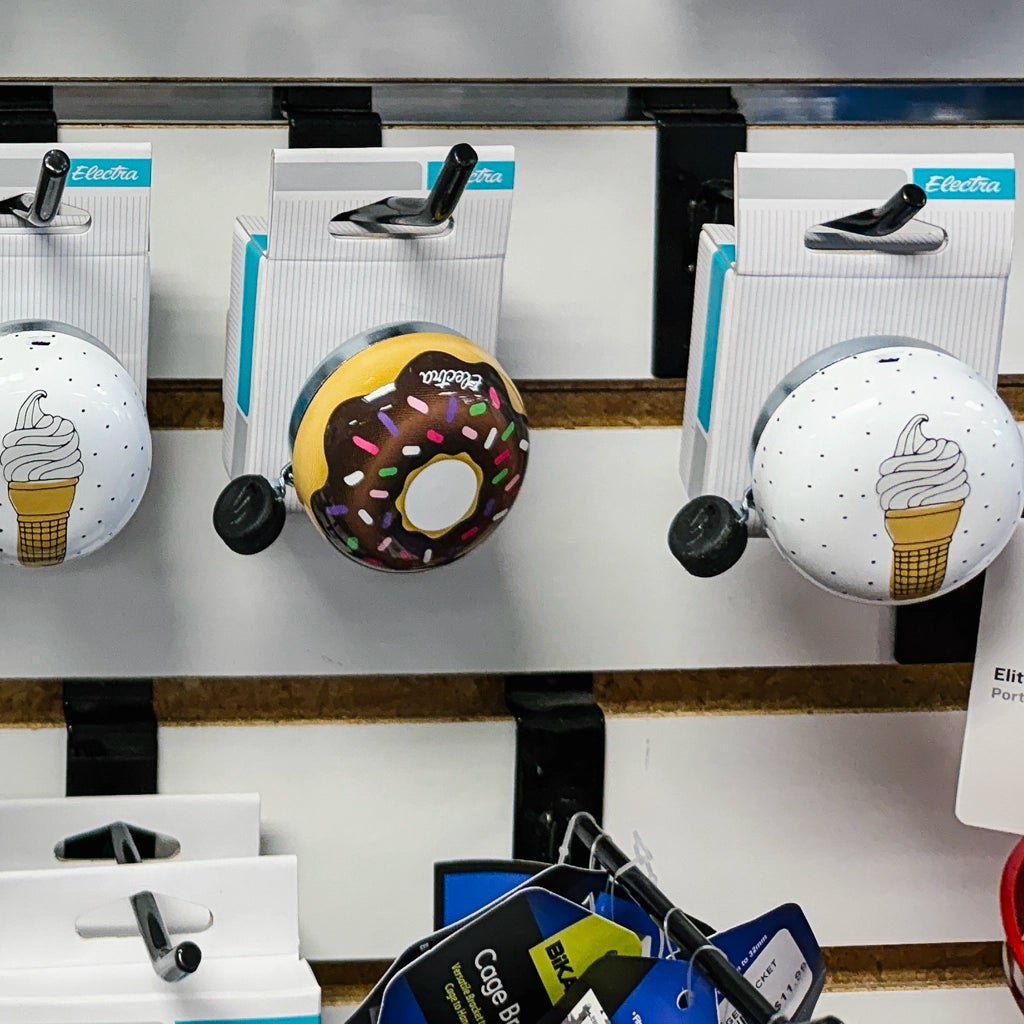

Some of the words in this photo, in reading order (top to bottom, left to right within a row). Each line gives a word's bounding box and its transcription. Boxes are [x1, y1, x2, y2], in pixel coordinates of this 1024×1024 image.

[71, 164, 140, 181] Electra
[467, 167, 504, 184] ctra
[925, 175, 1002, 193] Electra
[419, 369, 483, 391] Electra
[993, 667, 1024, 684] Elit
[991, 687, 1024, 703] Port
[748, 935, 768, 961] 32mm
[474, 948, 508, 1006] Cage
[755, 959, 777, 989] CKET
[444, 982, 458, 1002] Cage
[453, 1000, 462, 1011] to
[451, 962, 472, 995] Versatile
[466, 993, 484, 1021] Bracket
